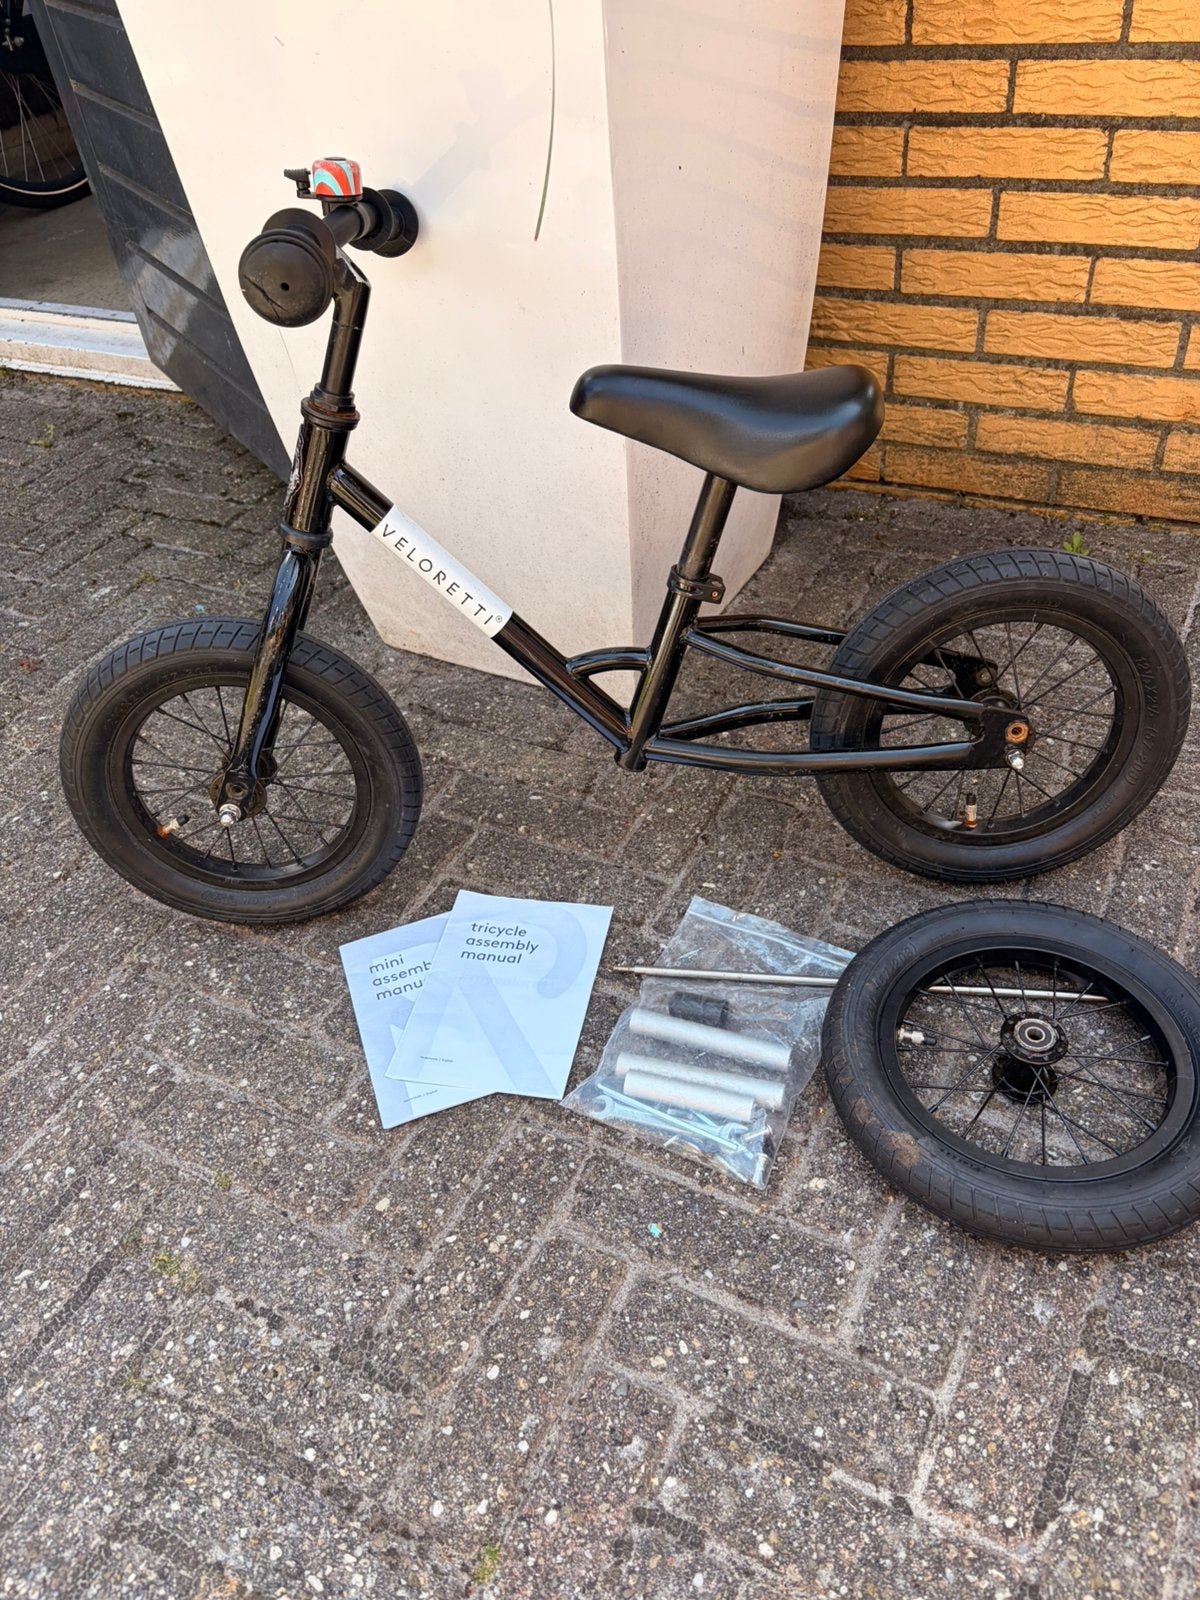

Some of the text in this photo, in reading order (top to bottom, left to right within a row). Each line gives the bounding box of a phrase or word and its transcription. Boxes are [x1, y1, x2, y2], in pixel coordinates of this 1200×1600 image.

[471, 922, 527, 937] tricycle
[465, 937, 539, 955] assembly
[369, 953, 404, 974] mini
[460, 950, 522, 964] manual
[372, 960, 433, 987] assemb
[376, 979, 427, 1001] manu
